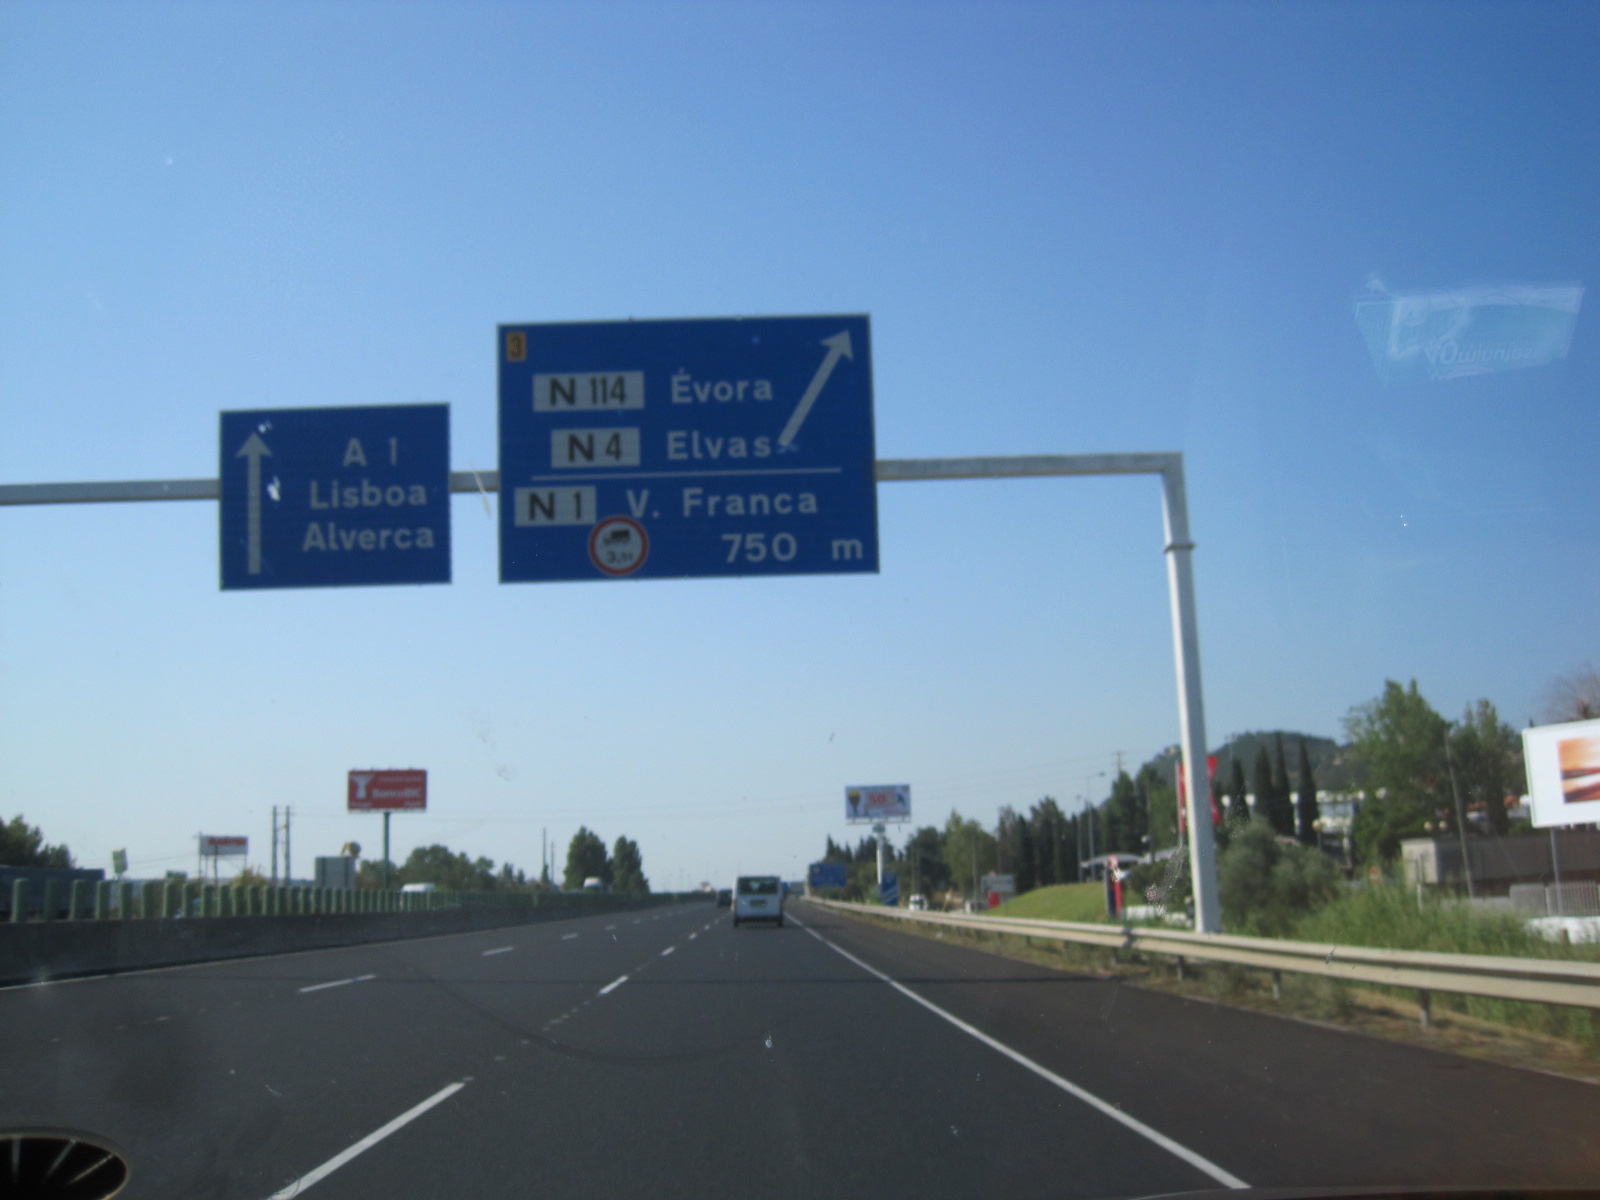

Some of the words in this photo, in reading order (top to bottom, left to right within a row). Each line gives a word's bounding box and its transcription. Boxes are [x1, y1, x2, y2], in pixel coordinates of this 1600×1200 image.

[510, 334, 523, 359] 3
[550, 376, 576, 406] N
[590, 375, 626, 405] 114
[670, 367, 773, 403] Évora
[342, 436, 368, 467] A
[388, 435, 398, 466] 1
[568, 432, 595, 463] N
[604, 431, 622, 461] 4
[667, 430, 772, 460] Elvas
[309, 478, 428, 510] Lisboa
[528, 490, 556, 521] N
[572, 490, 582, 520] 1
[626, 489, 661, 519] V.
[682, 487, 818, 517] Franca
[302, 521, 435, 552] Alverca
[720, 532, 798, 564] 750
[831, 538, 864, 561] m
